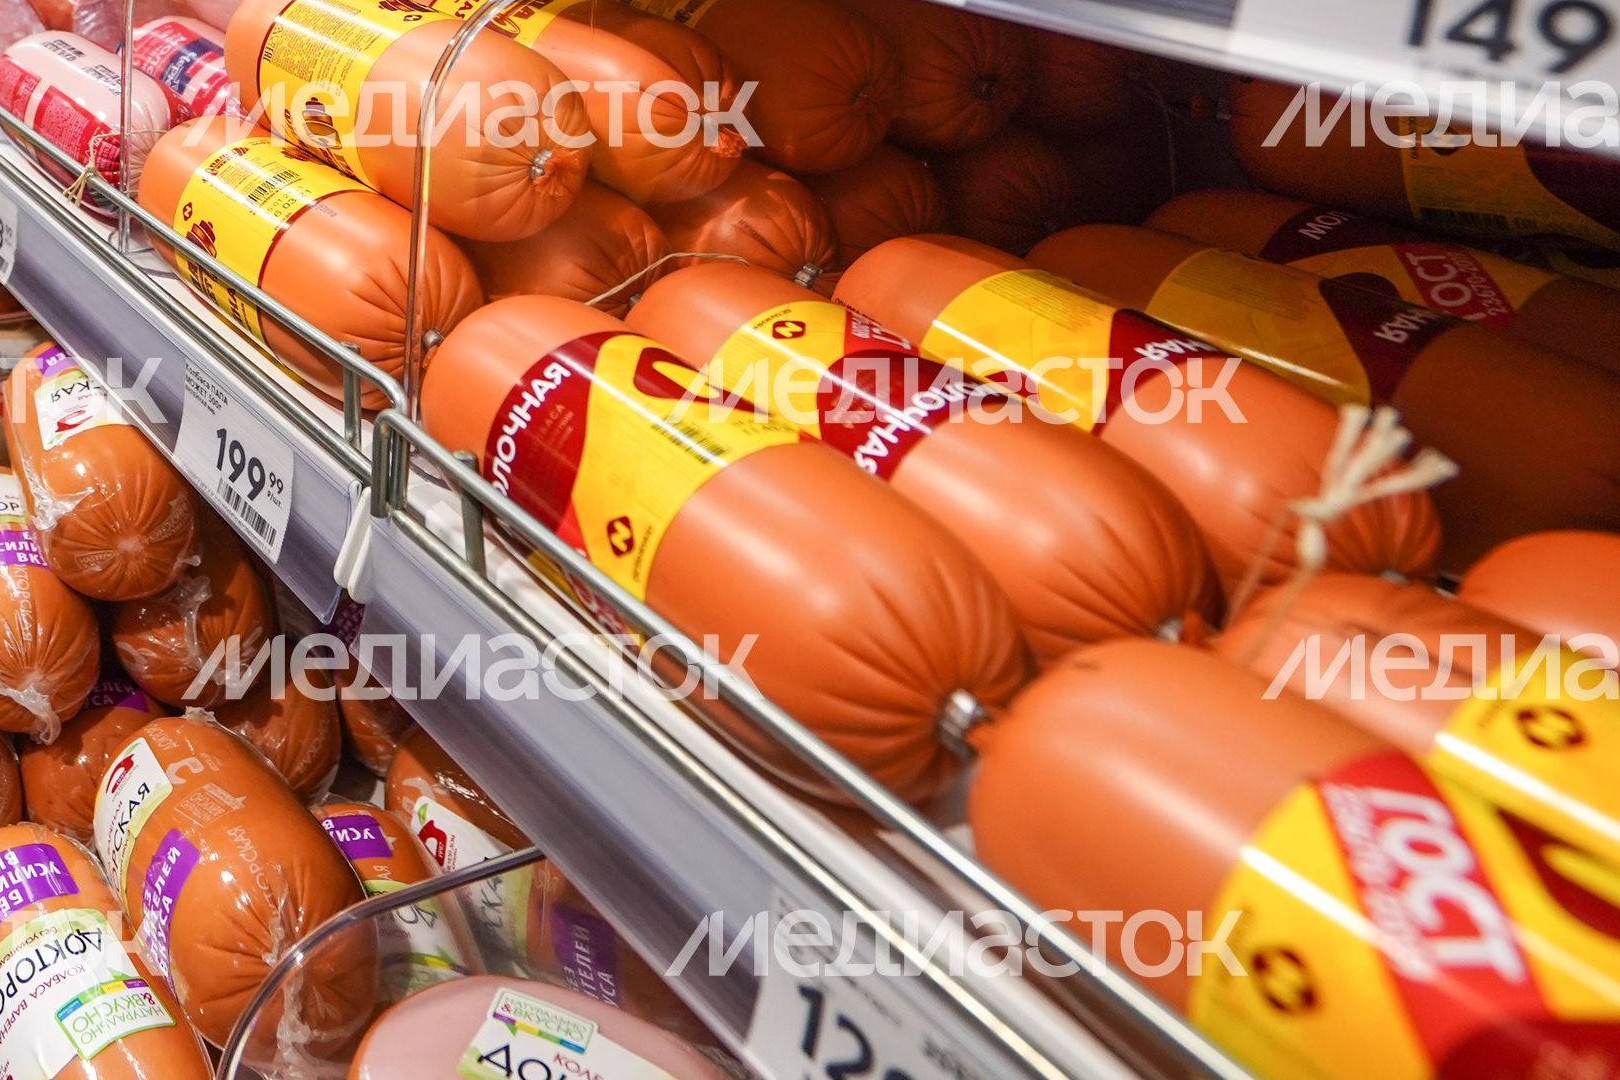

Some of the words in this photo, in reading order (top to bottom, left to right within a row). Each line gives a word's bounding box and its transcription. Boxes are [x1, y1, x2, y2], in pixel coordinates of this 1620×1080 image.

[185, 363, 211, 390] Колбаса
[210, 382, 229, 406] ПАПА
[185, 374, 208, 400] МОЖЕТ
[208, 393, 223, 411] 500г
[216, 428, 266, 502] 199
[269, 471, 284, 495] 99
[29, 964, 86, 1000] КОЛБАСА
[80, 1006, 166, 1046] НАТУРАЛЬНО
